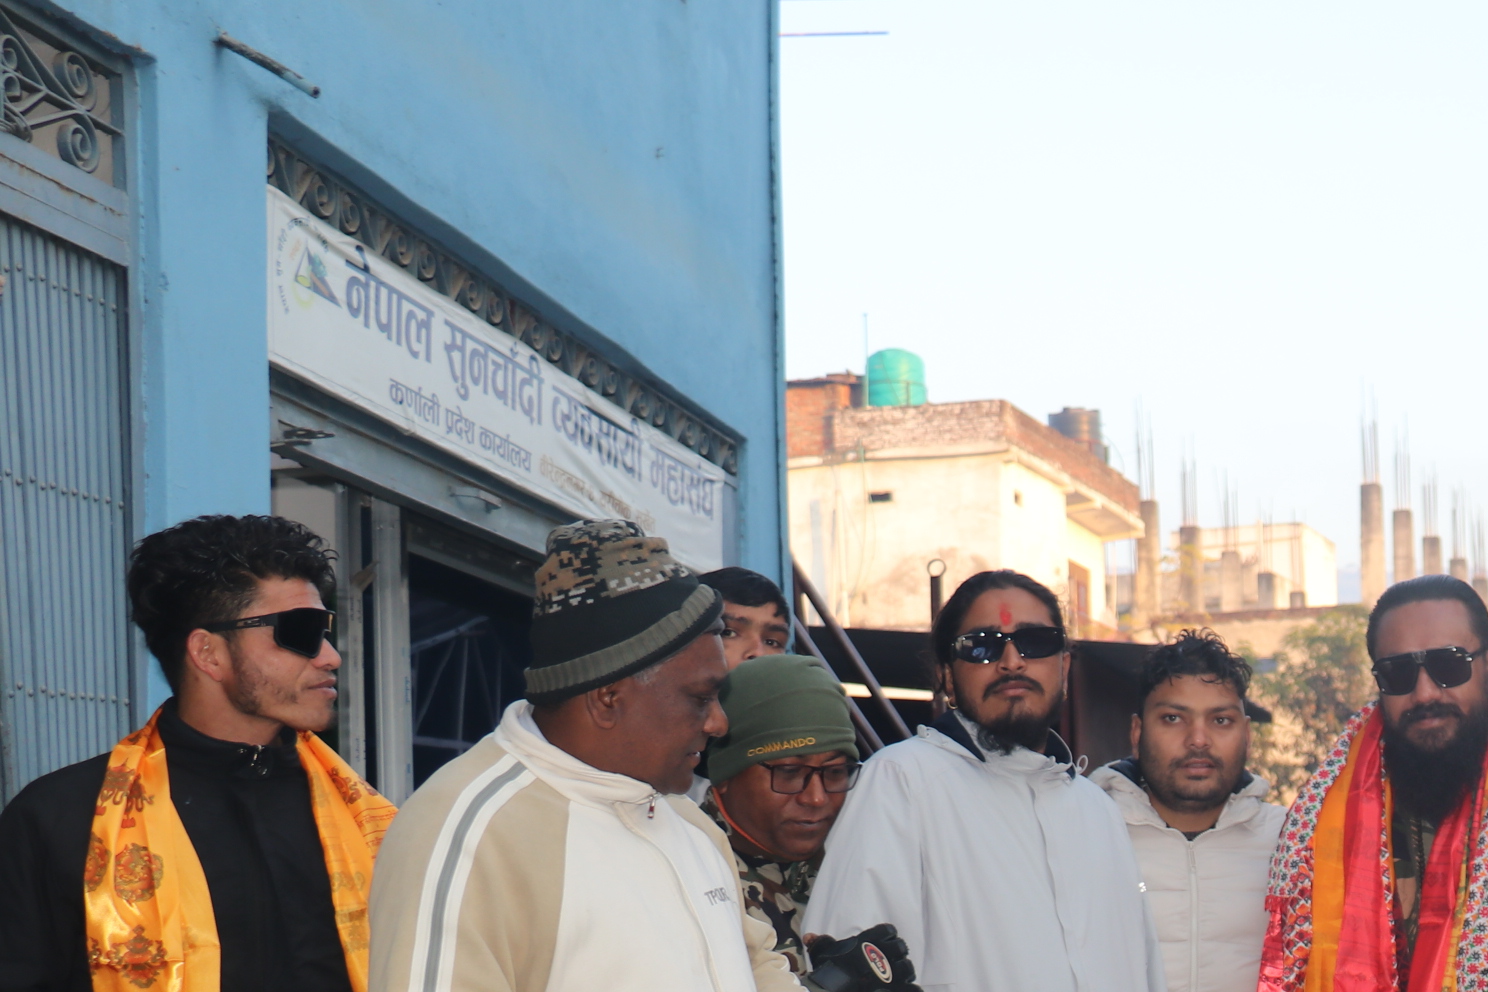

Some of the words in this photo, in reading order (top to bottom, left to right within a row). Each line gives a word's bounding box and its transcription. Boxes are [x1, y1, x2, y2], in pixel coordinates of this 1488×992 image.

[345, 245, 435, 363] नेपाल
[650, 443, 717, 520] महासंघ
[389, 378, 441, 426] कर्णाली
[445, 405, 475, 444] प्रदेश
[479, 426, 532, 473] कार्यालय
[747, 737, 816, 757] COMMANDO
